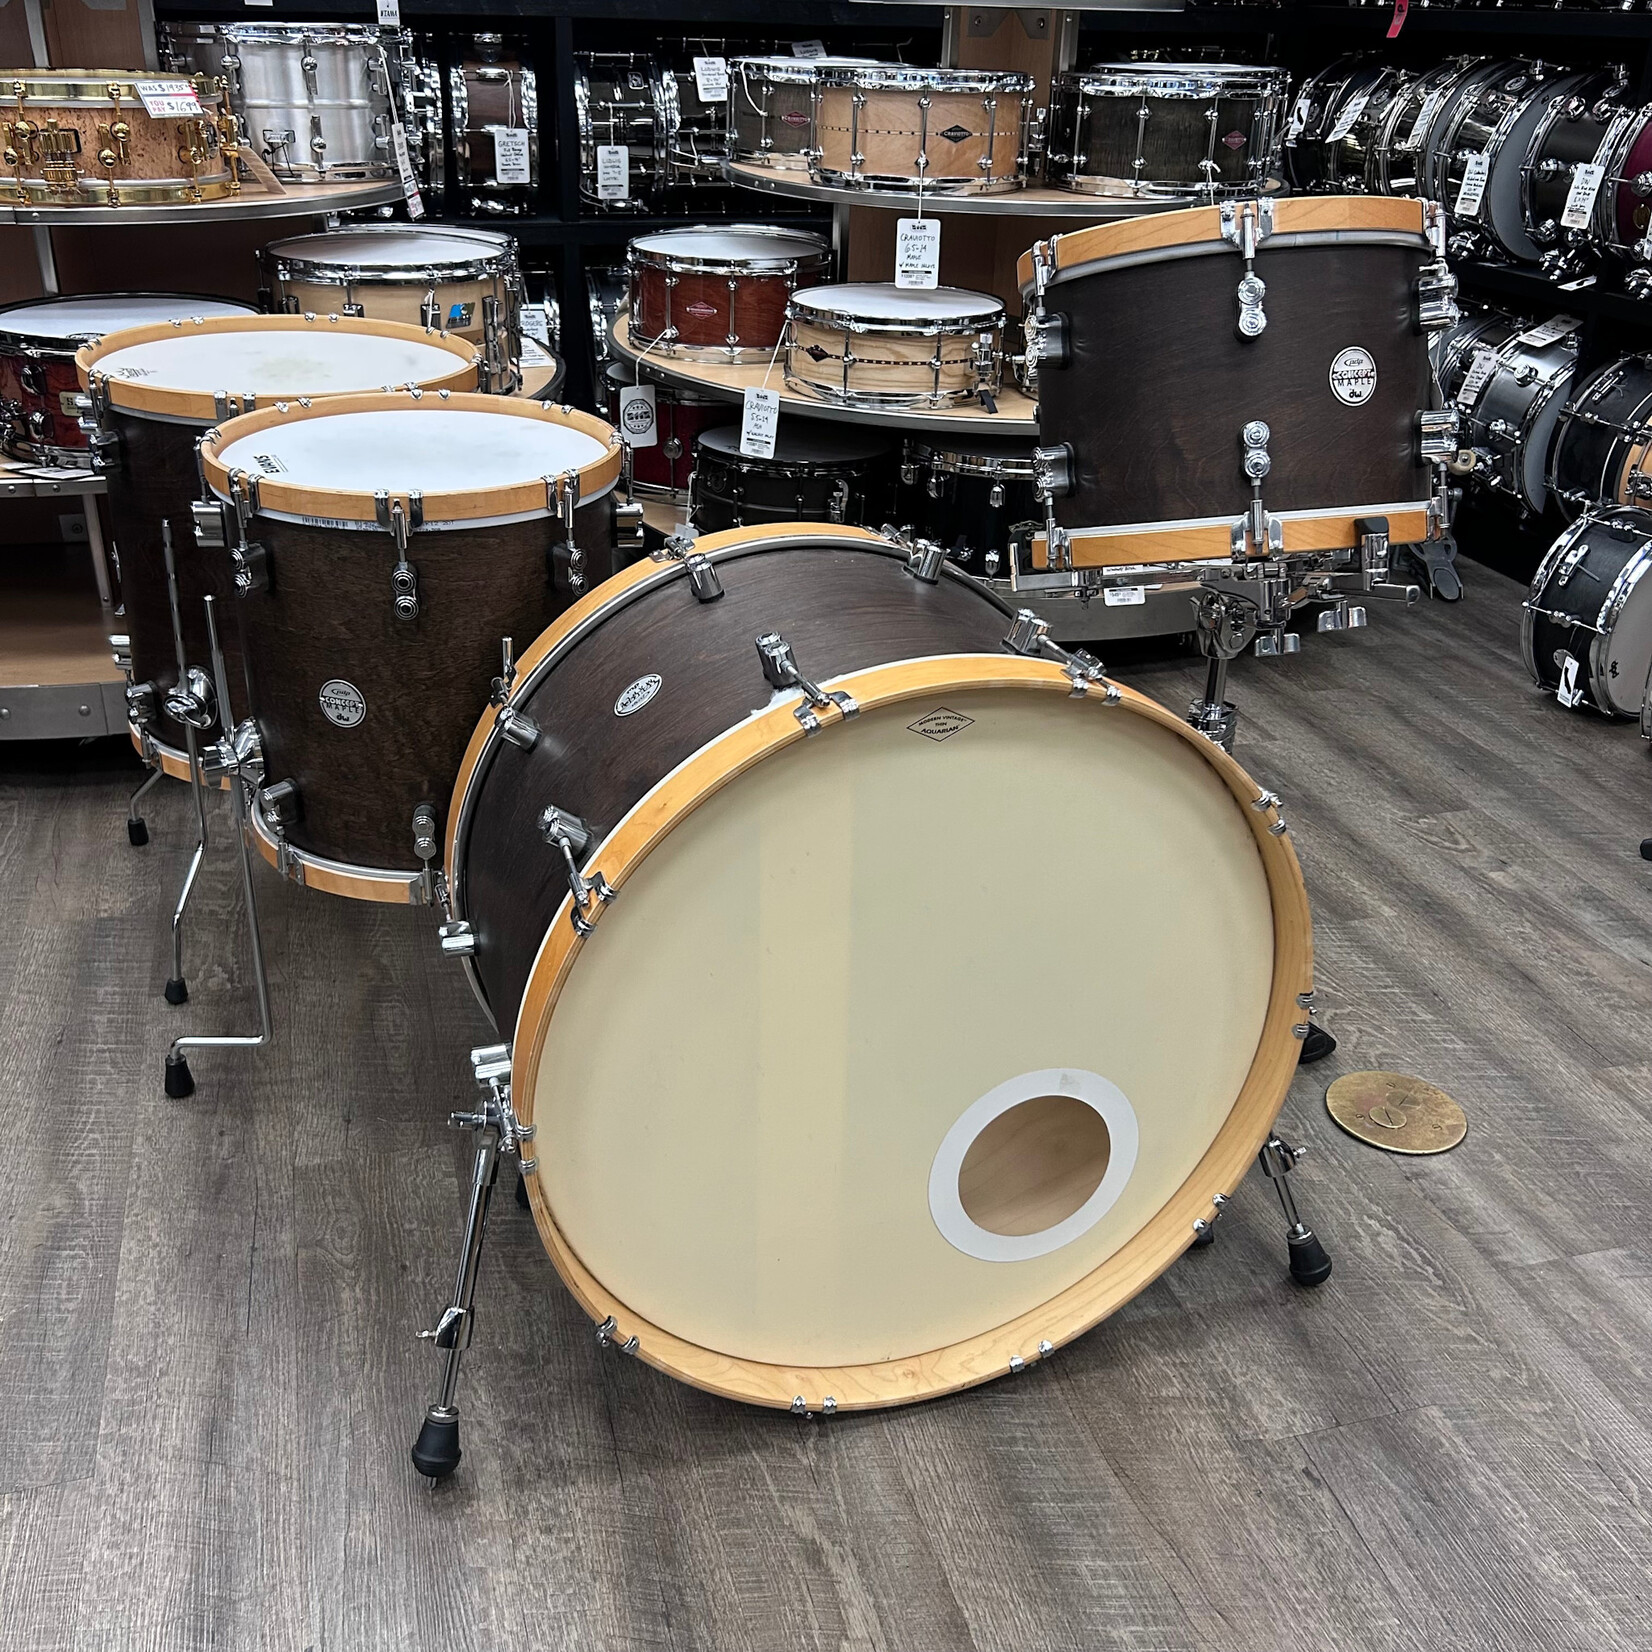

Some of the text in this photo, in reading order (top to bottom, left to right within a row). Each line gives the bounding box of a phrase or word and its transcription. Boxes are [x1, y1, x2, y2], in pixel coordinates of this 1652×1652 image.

[167, 101, 199, 112] $1699
[1337, 378, 1372, 388] MAPLE
[325, 696, 360, 708] CONCEPT
[326, 702, 360, 714] MAPLE
[918, 716, 941, 726] MODERN
[920, 725, 959, 735] AQUARIAN
